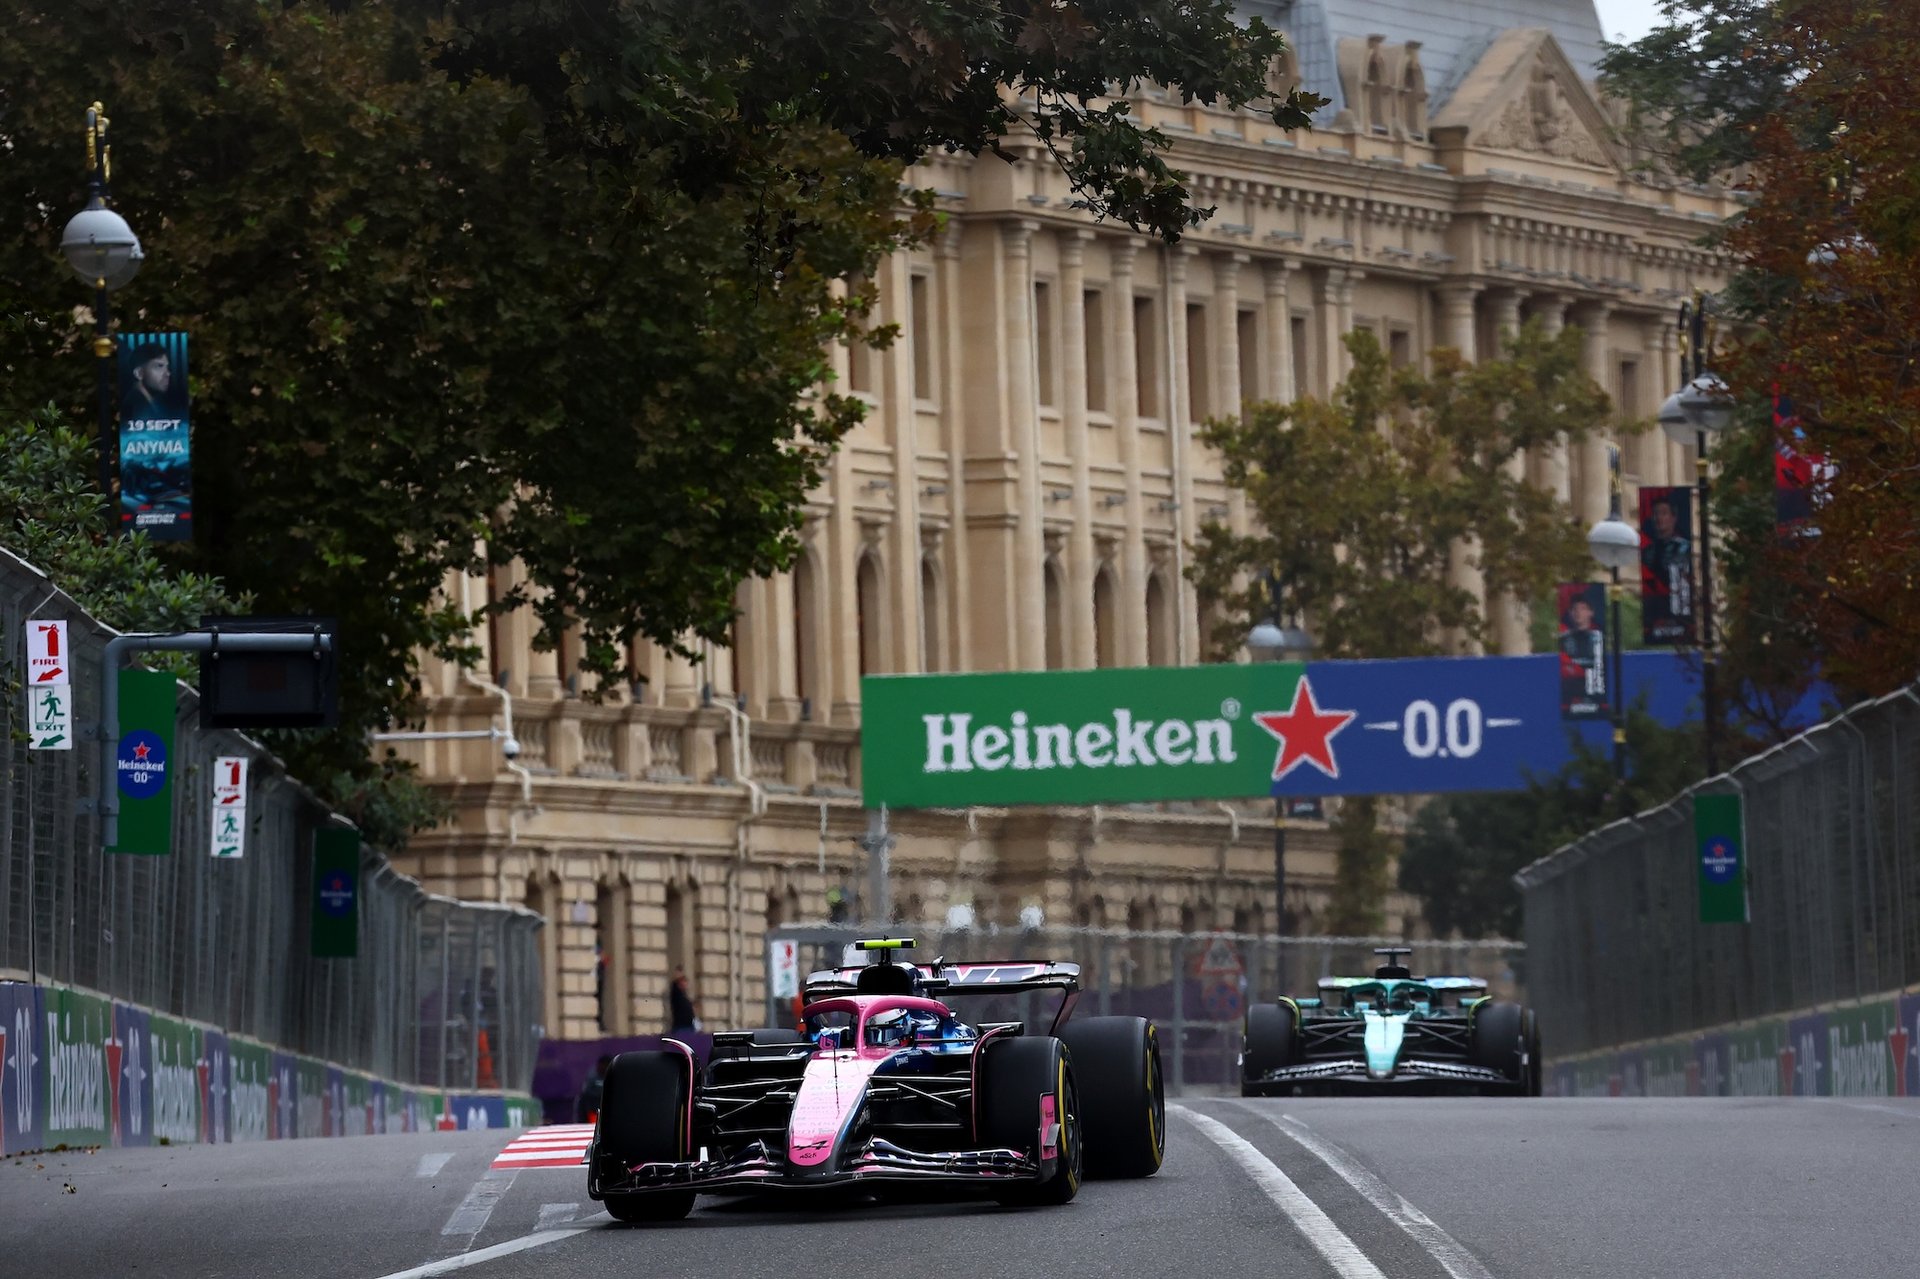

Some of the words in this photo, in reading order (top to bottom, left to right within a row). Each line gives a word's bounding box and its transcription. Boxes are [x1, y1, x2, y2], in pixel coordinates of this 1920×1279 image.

[127, 419, 145, 431] 19
[146, 418, 181, 431] SEPT
[125, 440, 185, 455] ANYMA
[32, 658, 60, 666] FIRE
[36, 724, 66, 732] EXIT
[922, 708, 1237, 773] Heineken
[118, 759, 165, 772] Heineken
[47, 1011, 105, 1131] Heineken
